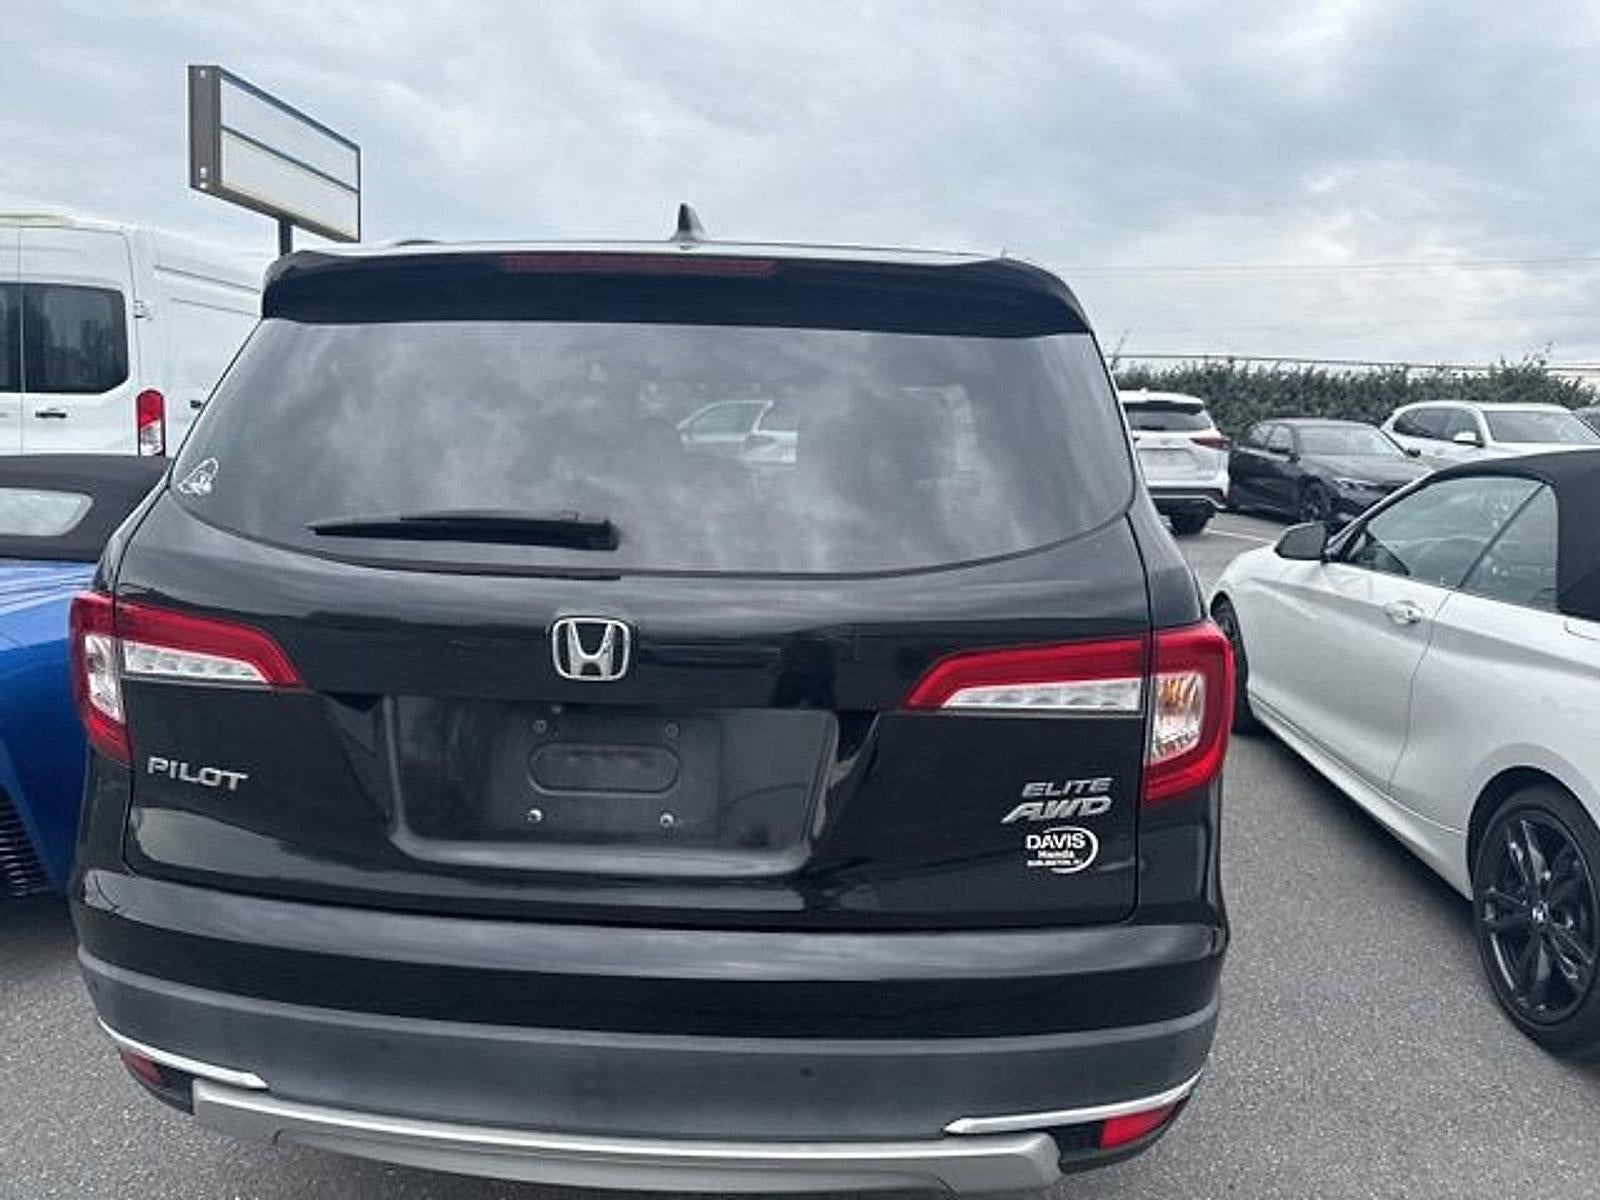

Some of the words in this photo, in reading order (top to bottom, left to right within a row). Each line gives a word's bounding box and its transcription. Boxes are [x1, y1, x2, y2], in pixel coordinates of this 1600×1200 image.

[147, 756, 248, 791] PILOT
[1022, 777, 1114, 797] ELITE
[1001, 796, 1112, 823] AWD
[1026, 832, 1086, 849] DAVIS
